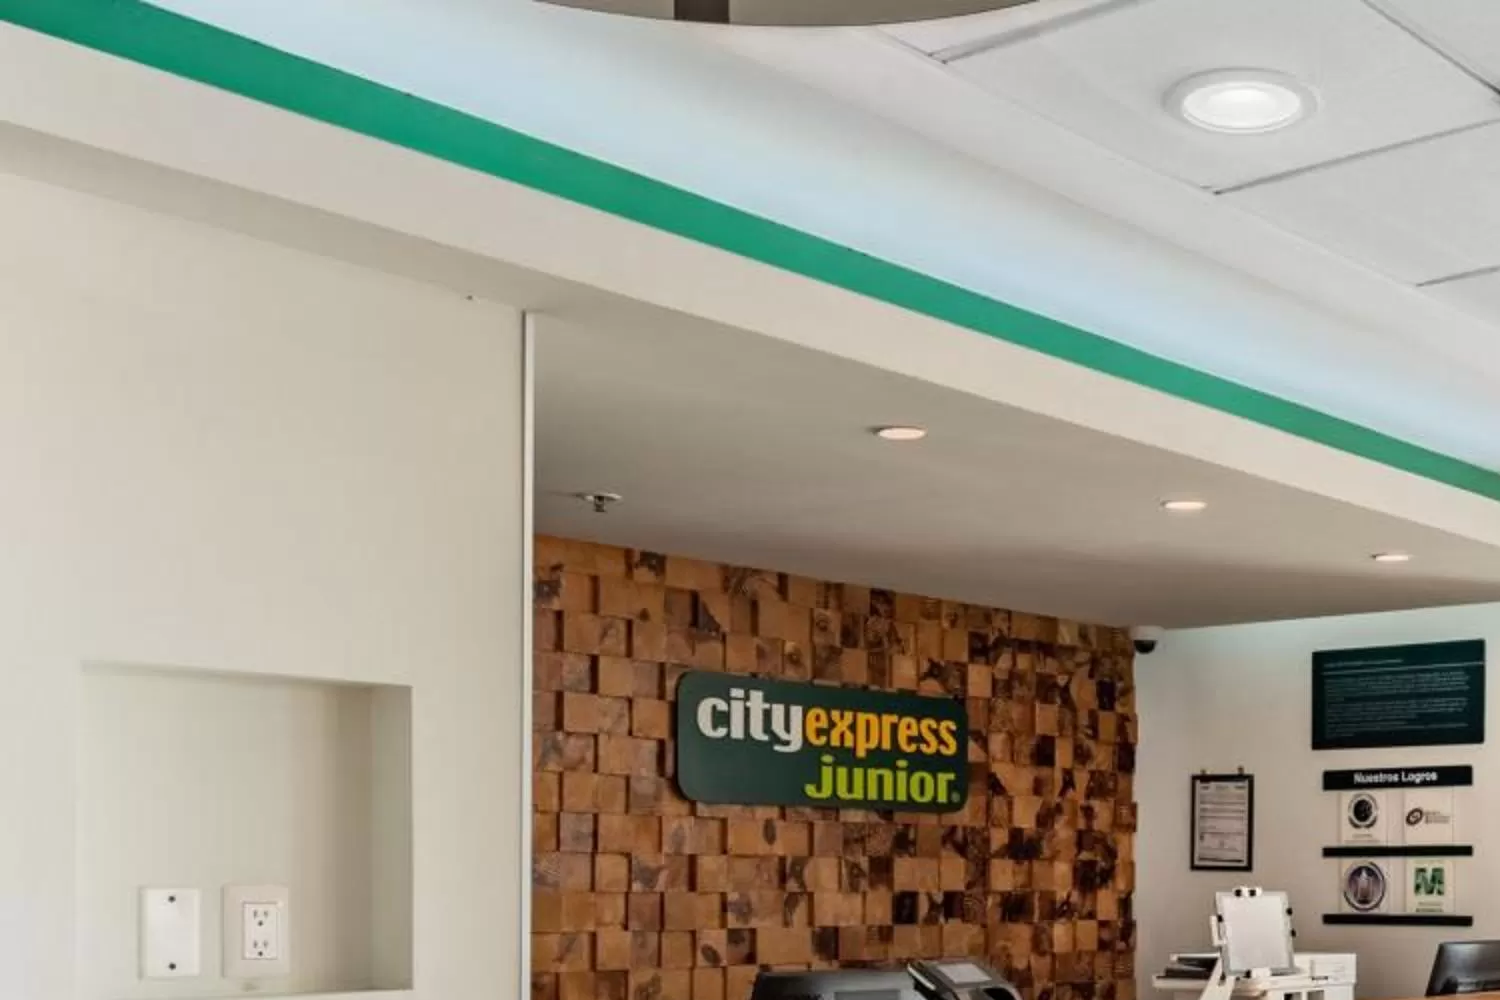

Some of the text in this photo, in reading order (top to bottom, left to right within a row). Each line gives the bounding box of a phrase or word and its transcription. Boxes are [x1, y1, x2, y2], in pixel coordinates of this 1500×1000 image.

[805, 754, 956, 803] junior
[1353, 769, 1438, 784] Nuestros Logros
